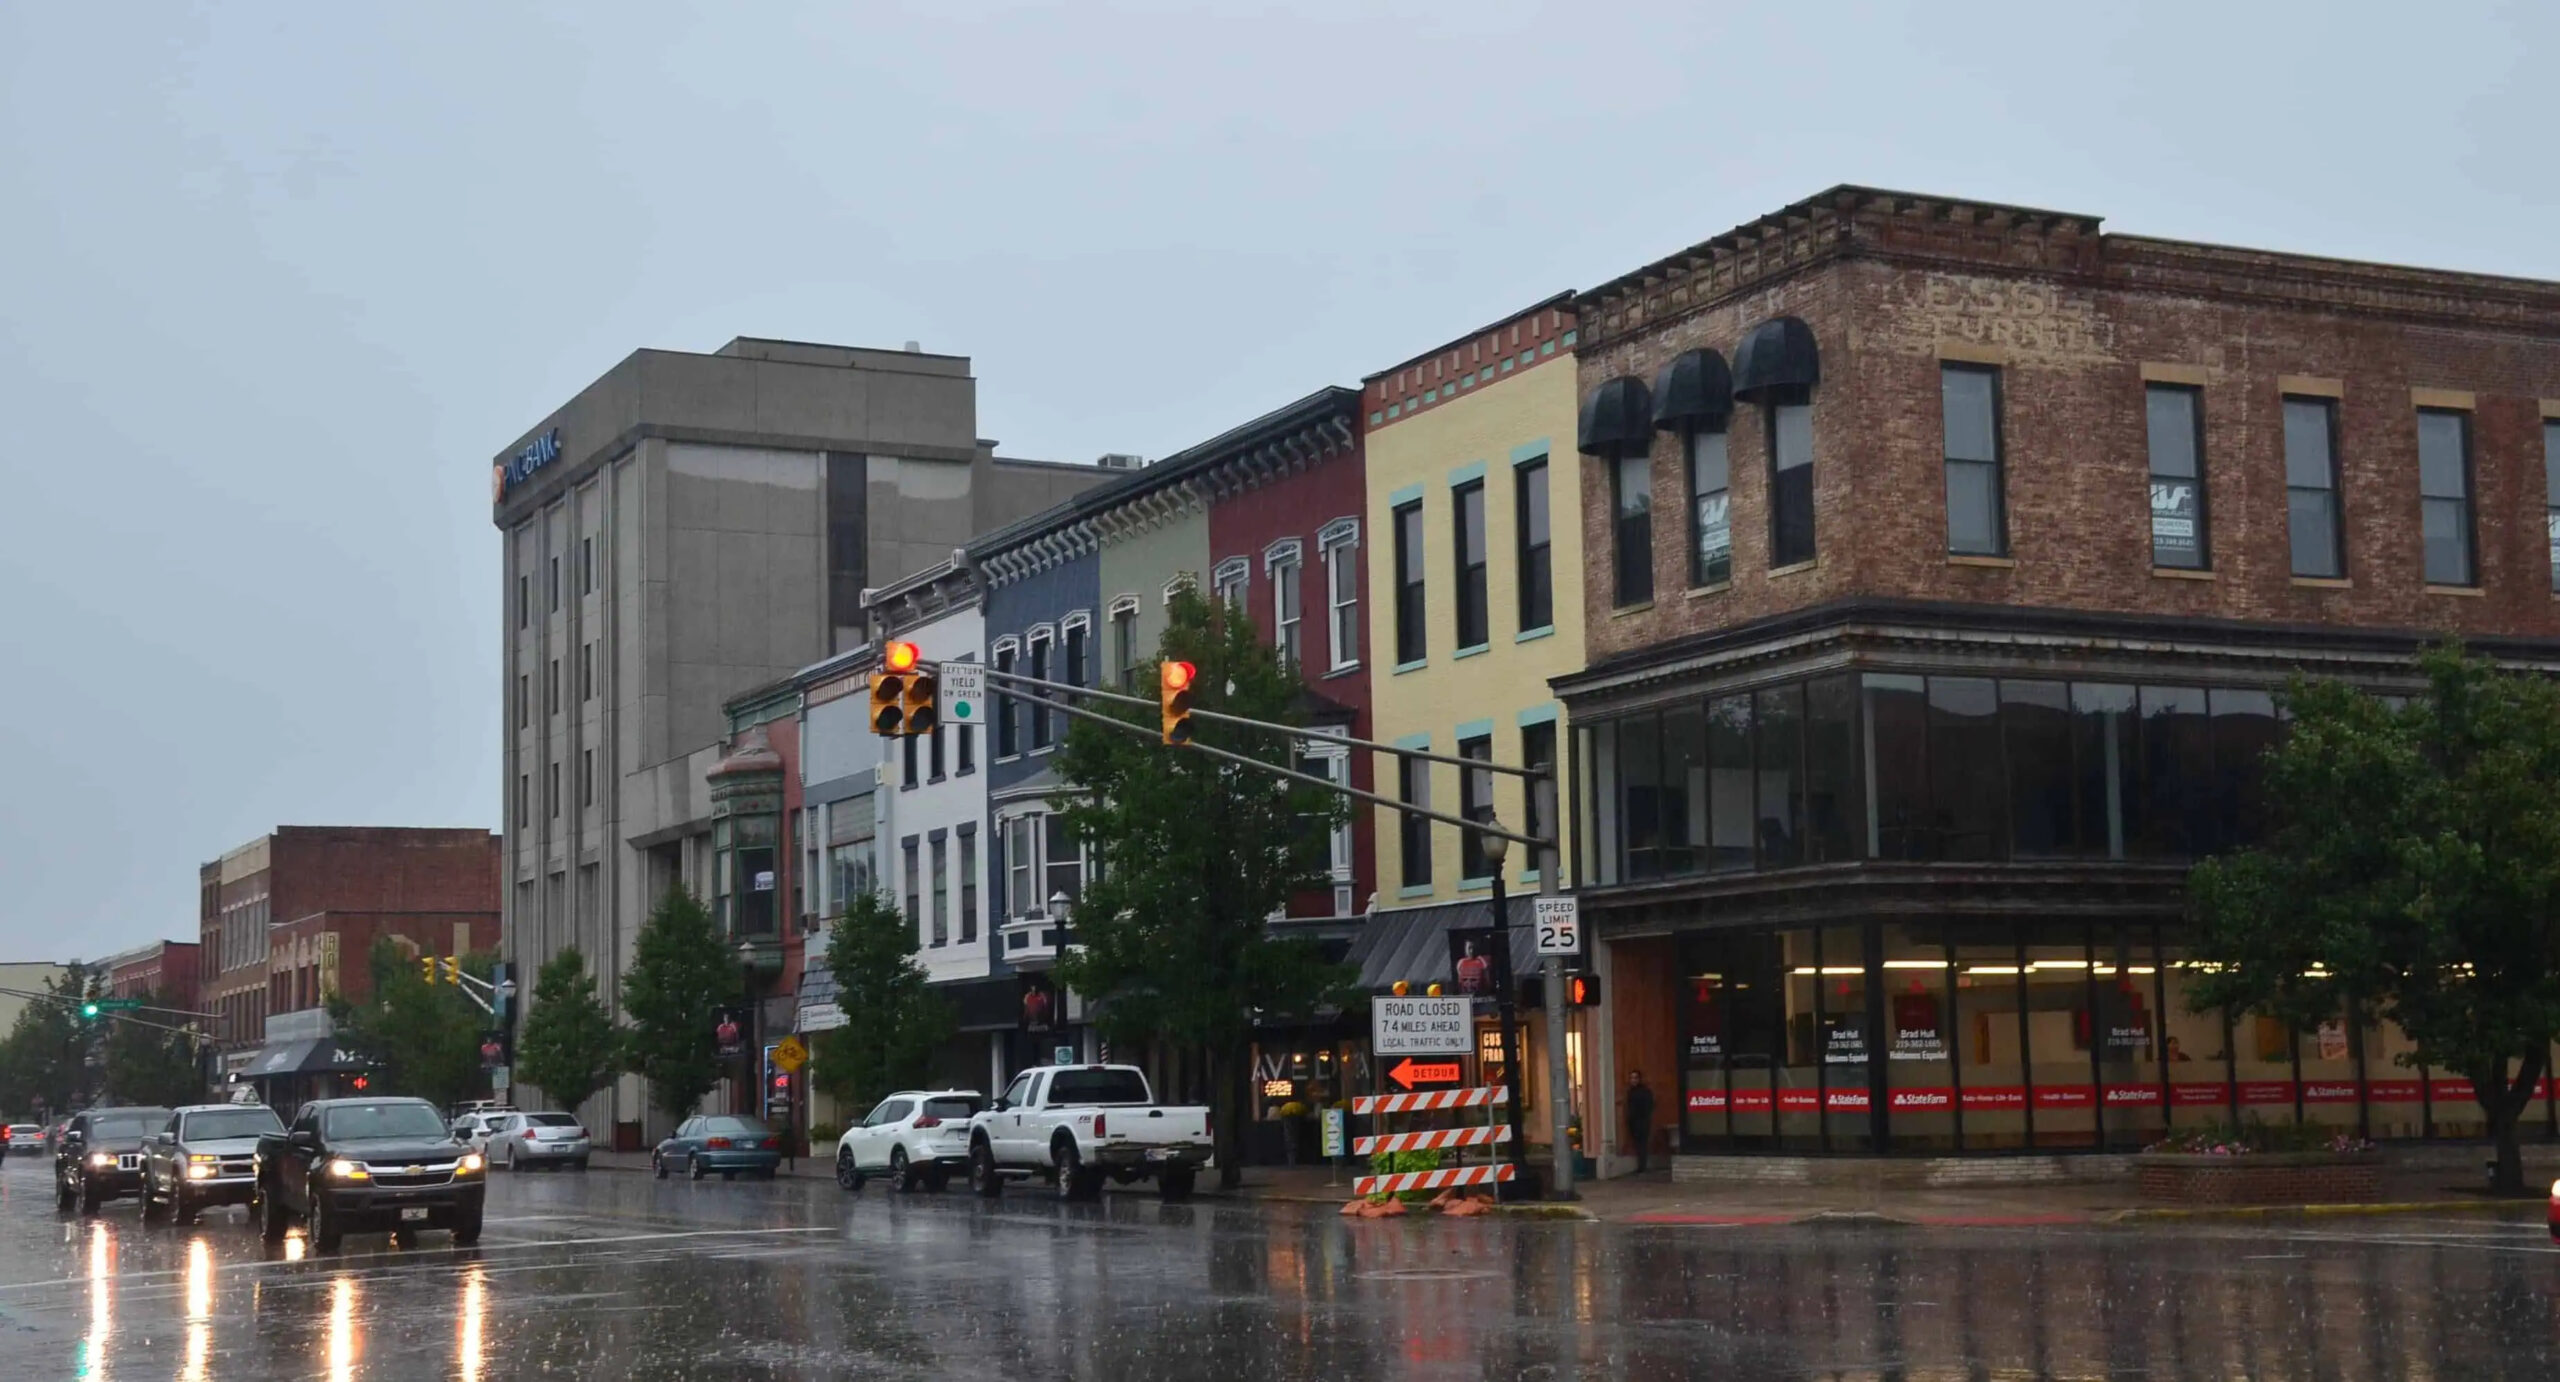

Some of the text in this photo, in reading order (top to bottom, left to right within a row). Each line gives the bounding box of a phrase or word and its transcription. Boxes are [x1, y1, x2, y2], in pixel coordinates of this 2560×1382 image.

[942, 665, 983, 676] LEFT TURN
[951, 678, 976, 688] YIELD
[943, 689, 982, 698] ON GREEN
[1538, 902, 1575, 913] SPEED
[1542, 914, 1571, 925] LIMIT
[1541, 926, 1575, 948] 25
[1385, 1002, 1460, 1016] ROAD CLOSED
[1401, 1021, 1427, 1033] MILES
[1430, 1021, 1460, 1032] AHEAD
[1900, 1029, 1918, 1039] Brad
[1383, 1037, 1464, 1048] LOCAL TRAFFIC ONLY
[1413, 1067, 1456, 1079] DETOUR
